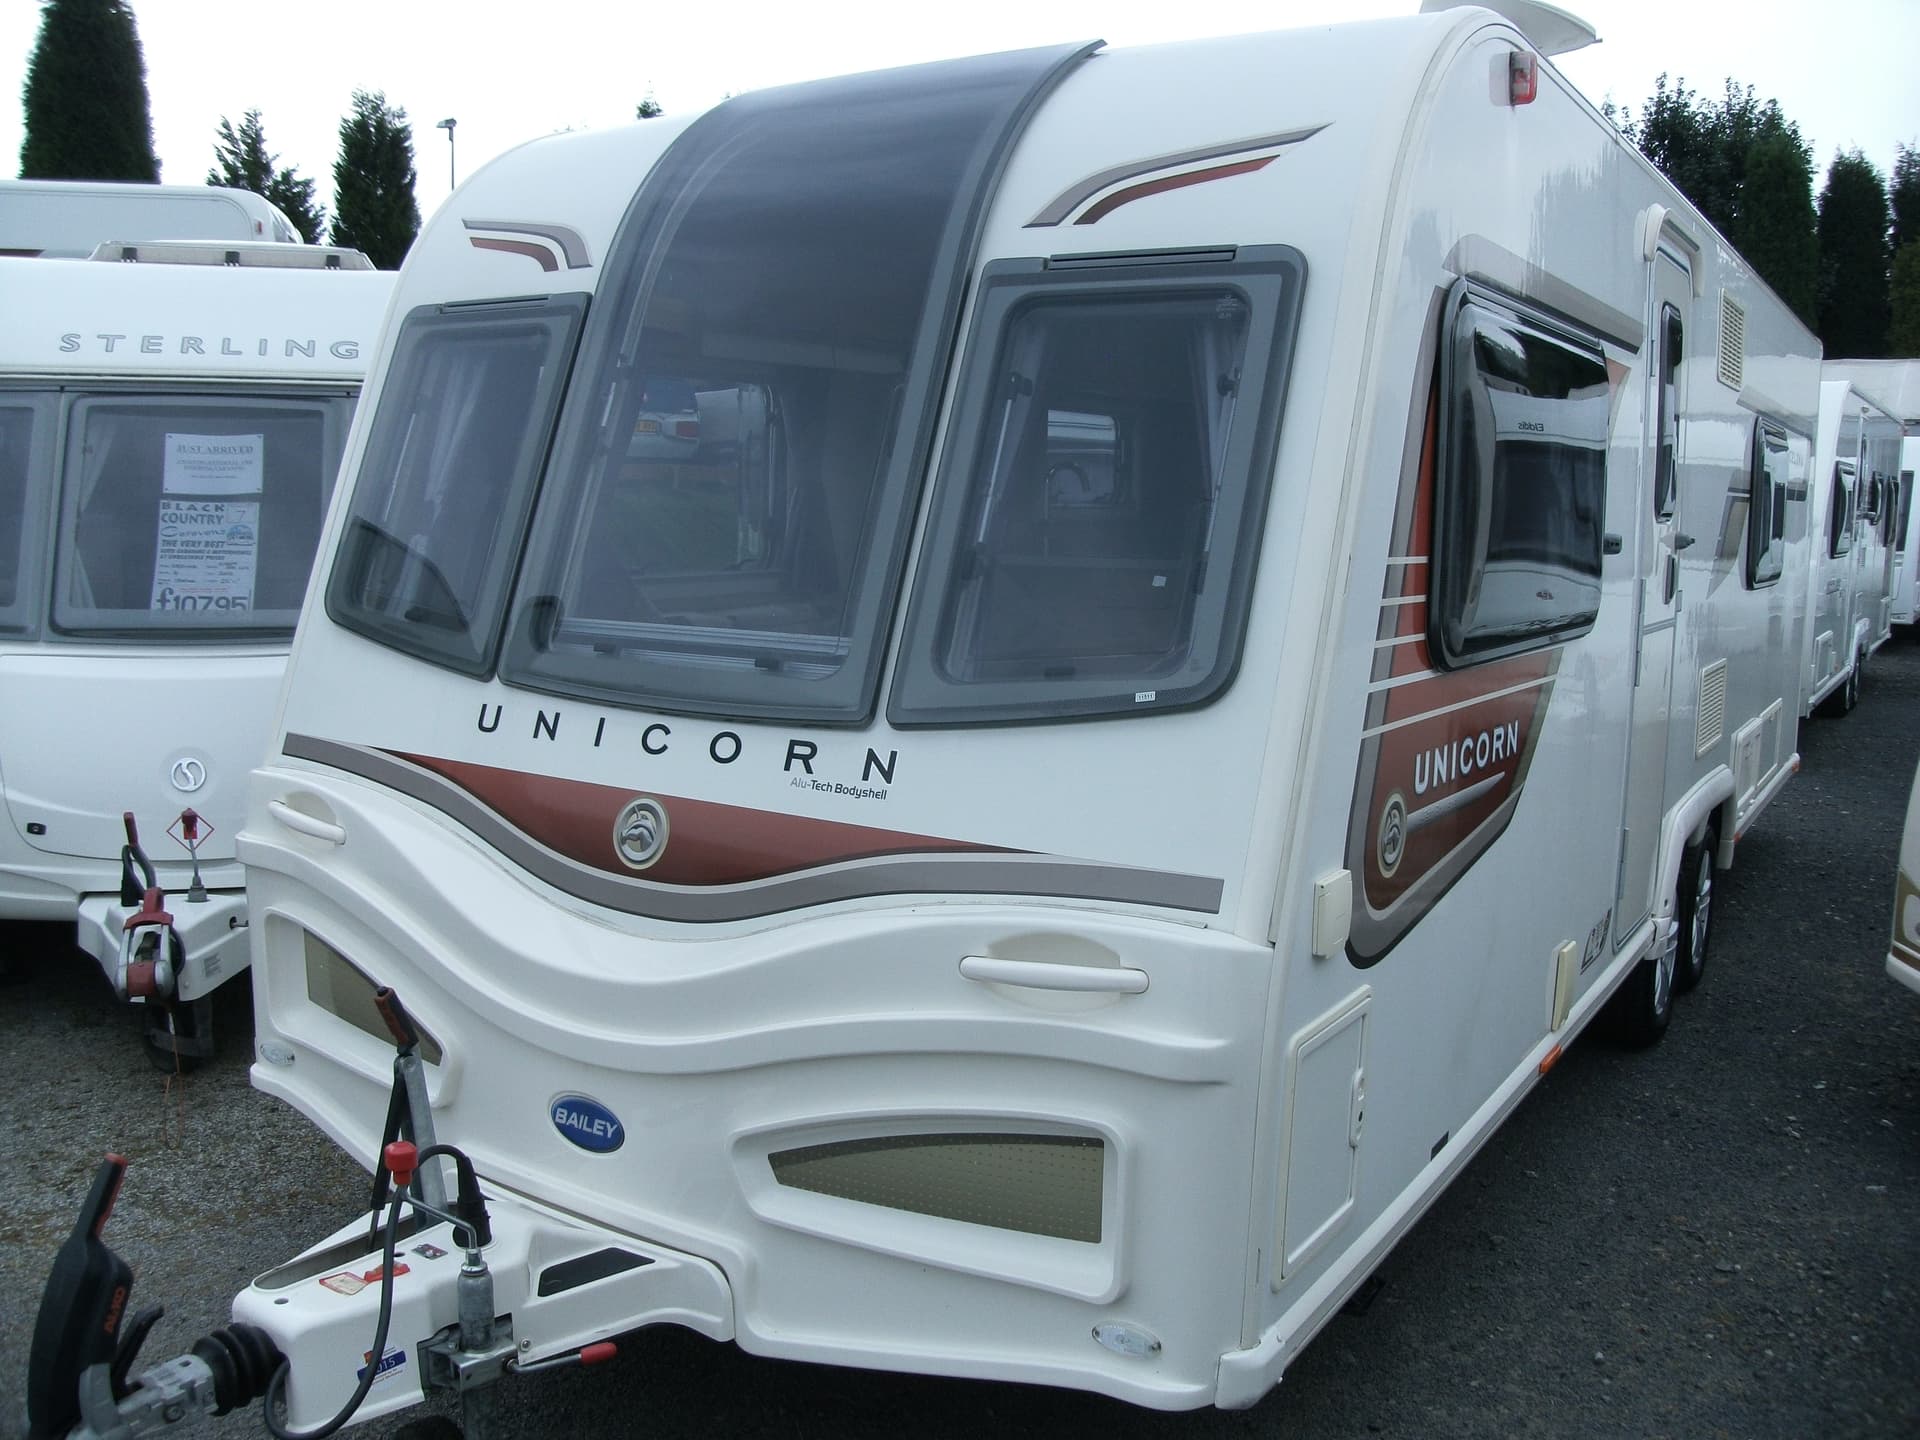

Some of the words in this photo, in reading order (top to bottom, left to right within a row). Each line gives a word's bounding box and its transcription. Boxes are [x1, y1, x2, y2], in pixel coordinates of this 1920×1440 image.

[59, 333, 360, 360] STERLING
[161, 512, 224, 526] COUNTRY
[162, 502, 225, 513] BLACK
[162, 540, 178, 548] THE
[181, 540, 203, 549] VERY
[205, 541, 226, 549] BEST
[477, 703, 899, 785] UNICORN
[1413, 719, 1520, 796] UNICORN
[790, 777, 833, 793] Alu-Tech
[834, 783, 888, 800] Bodyshell
[555, 1107, 618, 1139] BAILEY
